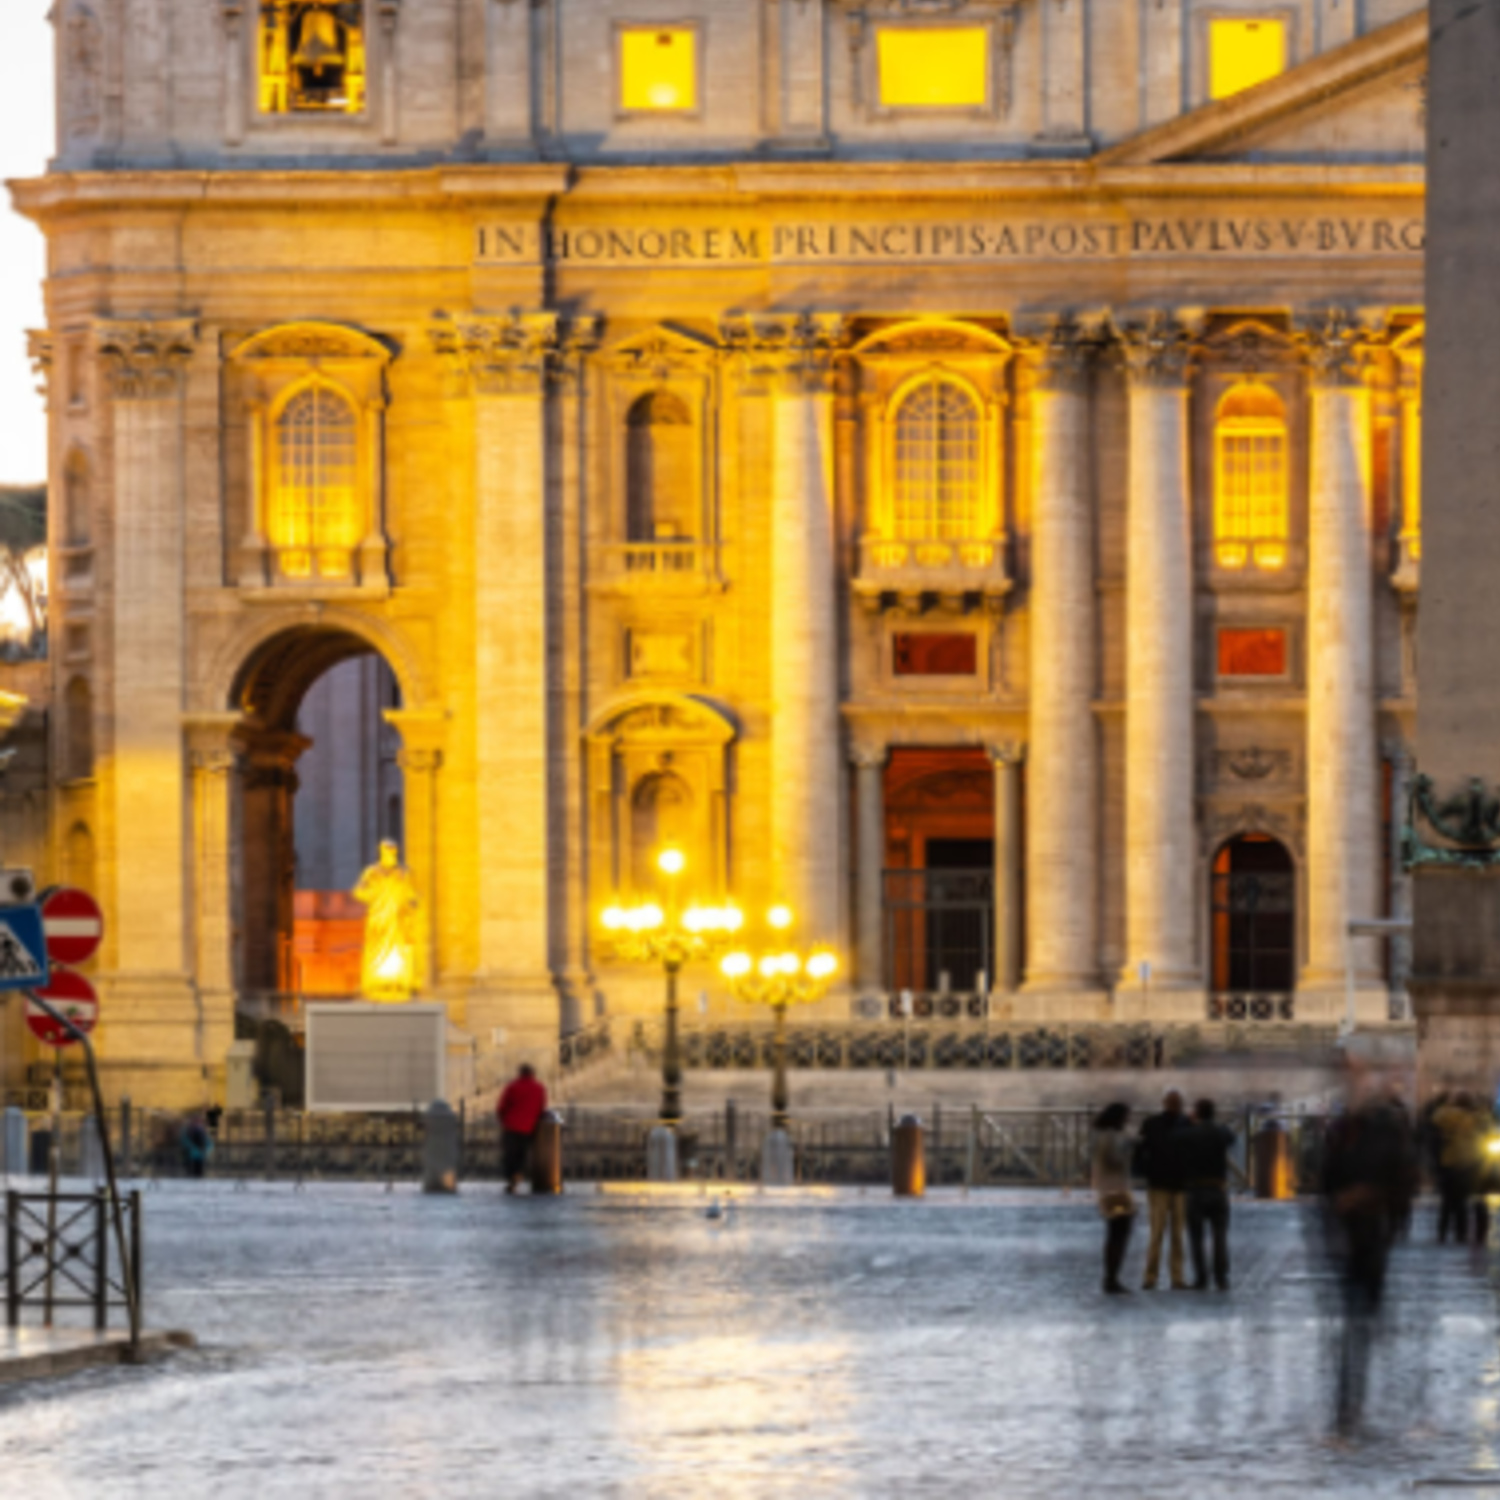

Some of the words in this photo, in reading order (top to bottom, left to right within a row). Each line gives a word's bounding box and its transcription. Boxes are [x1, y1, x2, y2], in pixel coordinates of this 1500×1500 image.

[478, 225, 523, 256] IN
[546, 228, 762, 259] HONOREM
[772, 224, 987, 255] PRINCIPIS
[995, 224, 1127, 255] APOST
[1131, 218, 1272, 251] PAVLVS
